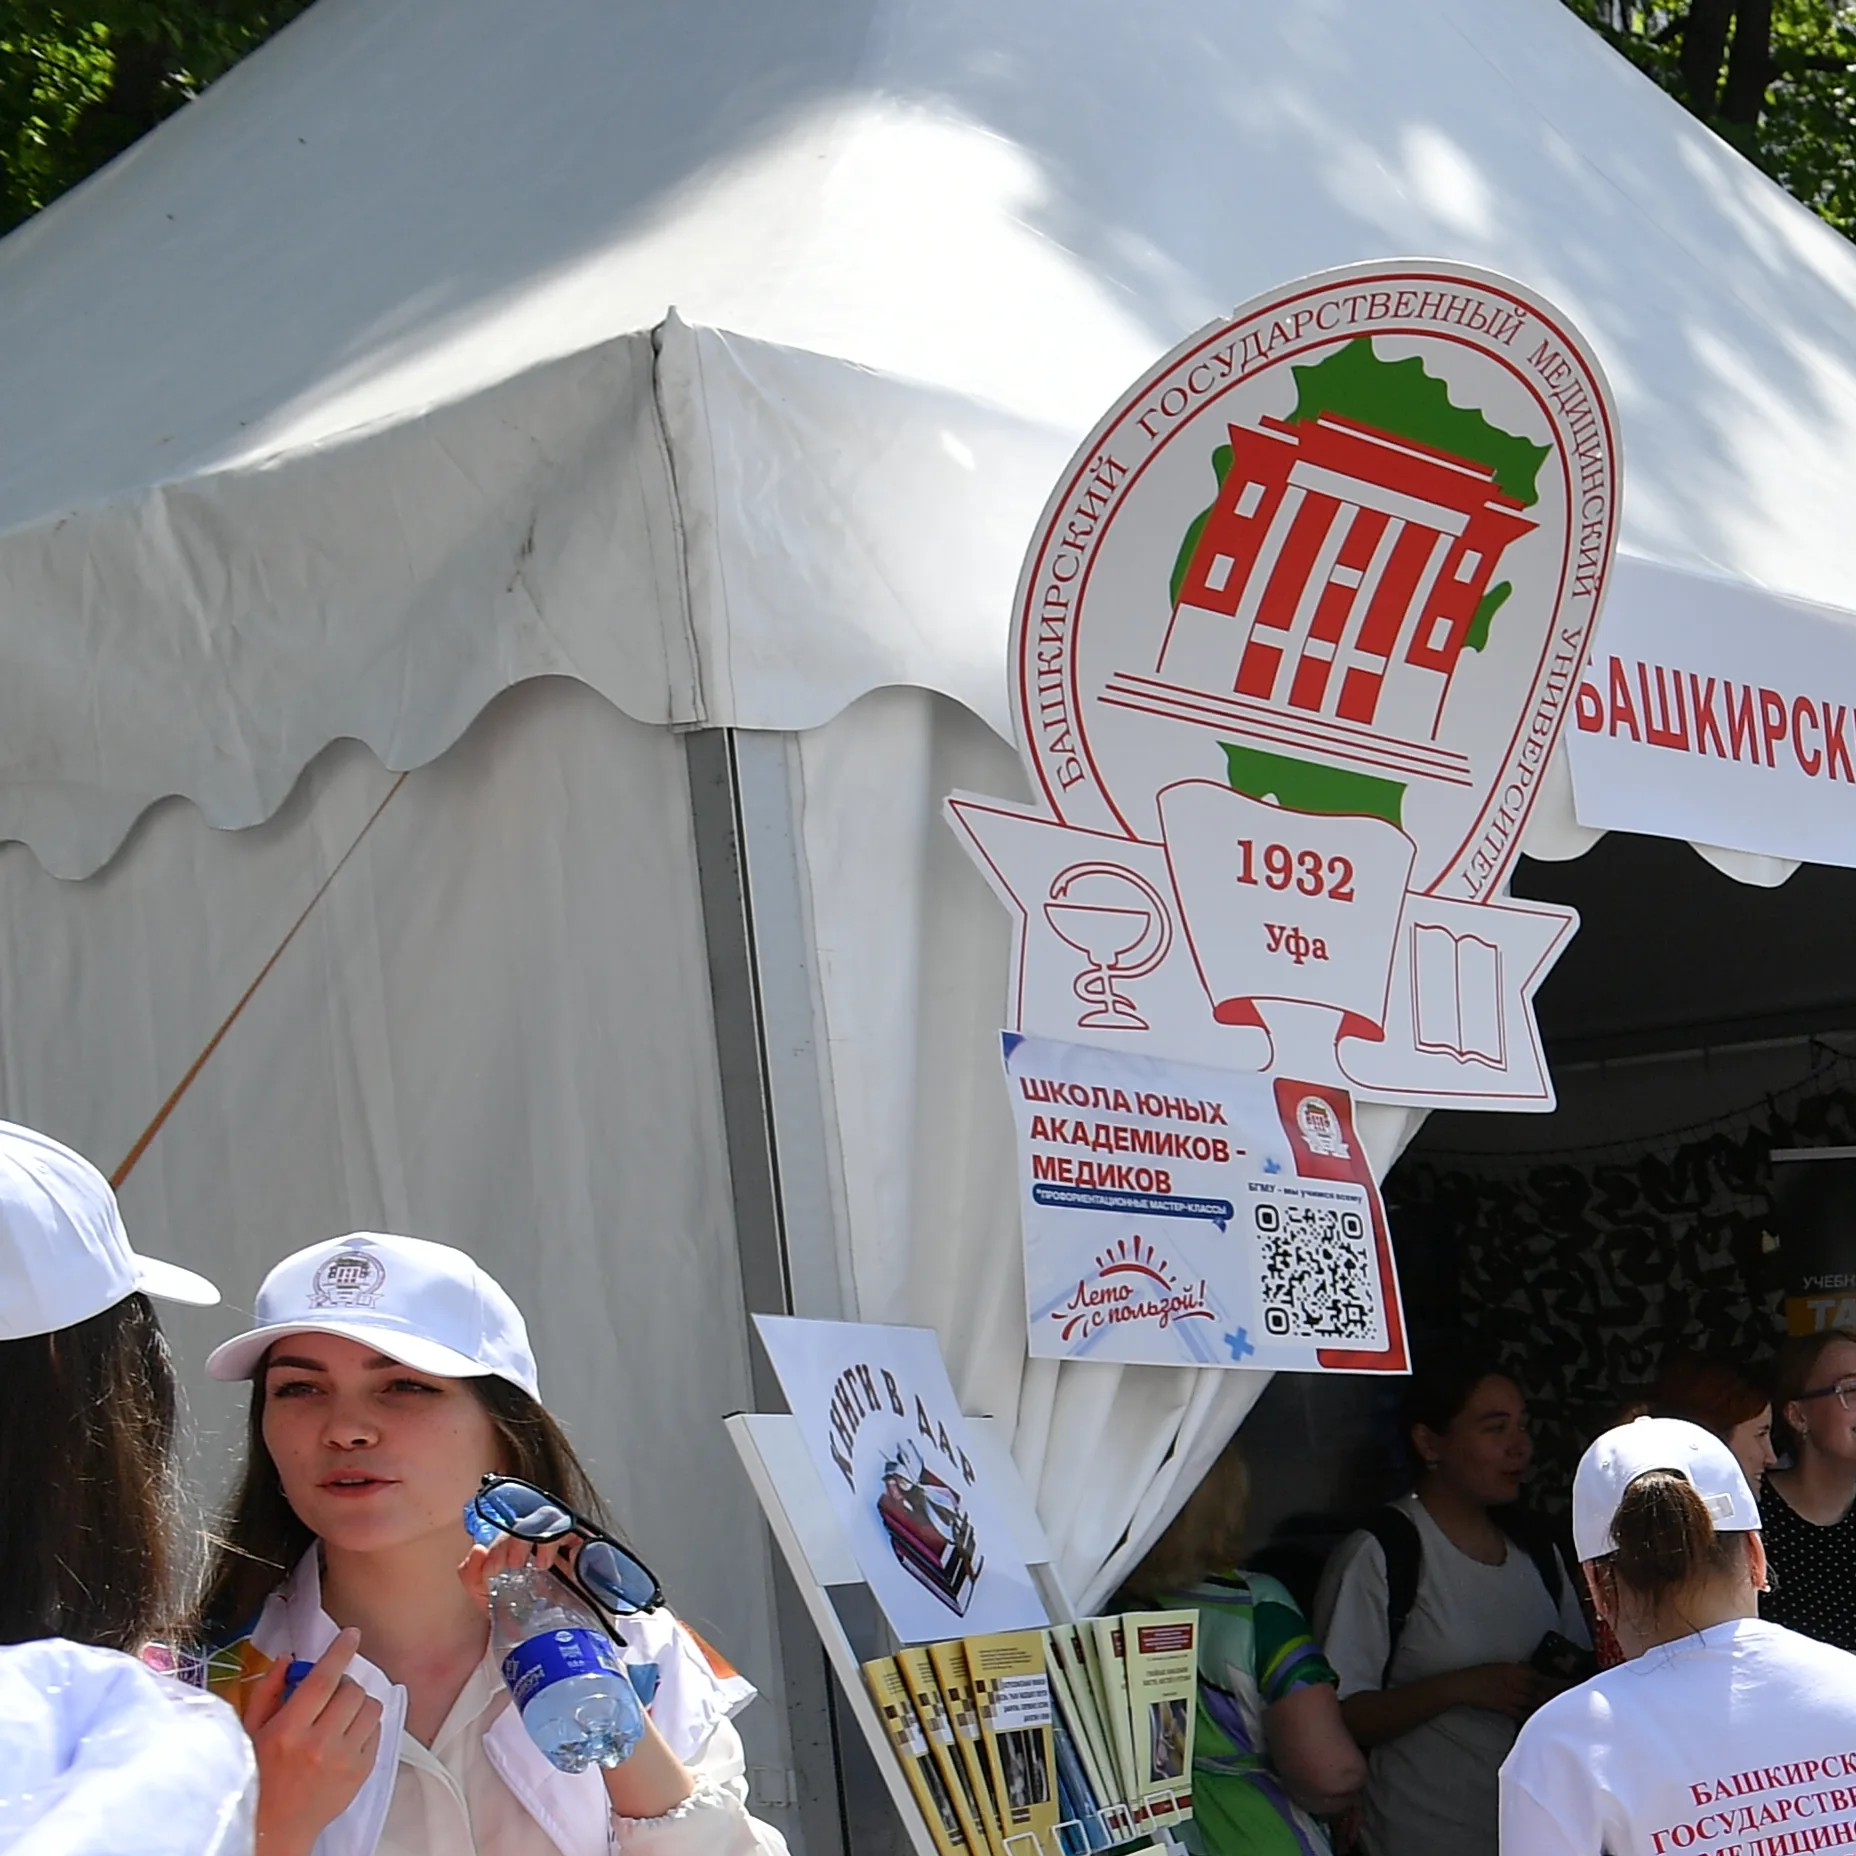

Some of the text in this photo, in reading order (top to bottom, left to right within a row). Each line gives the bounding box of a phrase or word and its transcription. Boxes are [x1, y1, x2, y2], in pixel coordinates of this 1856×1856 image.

[1034, 289, 1608, 900] БАШКИРСКИЙ ГОСУДАРСТВЕННЫЙ МЕДИЦИНСКИЙ УНИВЕРСИТЕТ
[1235, 837, 1355, 903] 1932
[1263, 920, 1330, 964] Уфа
[1019, 1077, 1229, 1126] ШКОЛА ЮНЫХ
[1030, 1115, 1230, 1163] АКАДЕМИКОВ
[1032, 1154, 1173, 1195] МЕДИКОВ
[1067, 1280, 1133, 1311] Лето
[1091, 1279, 1207, 1330] с пользой!
[829, 1363, 882, 1495] КНИГИ
[880, 1367, 905, 1418] В
